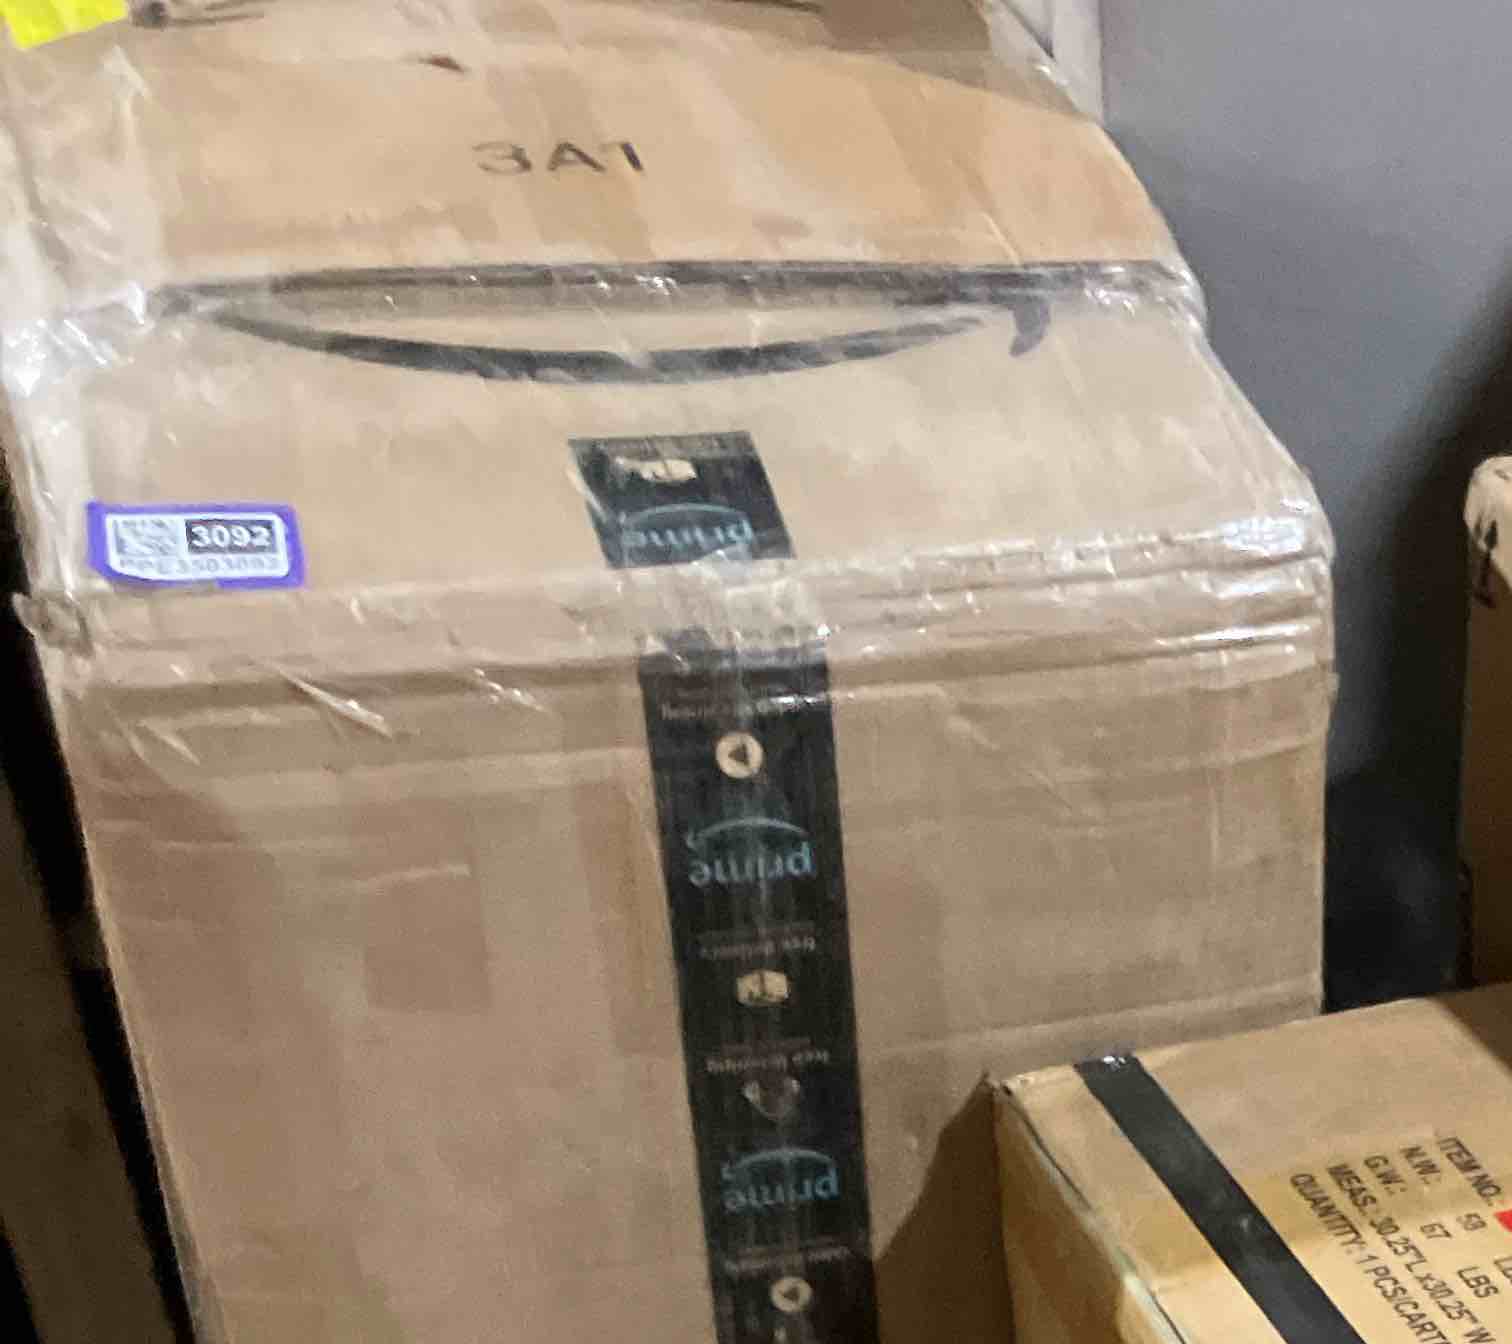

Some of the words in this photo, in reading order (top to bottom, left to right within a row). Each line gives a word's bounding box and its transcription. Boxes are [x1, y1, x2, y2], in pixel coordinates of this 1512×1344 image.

[190, 525, 271, 549] 3092
[688, 842, 816, 888] prime
[723, 1162, 841, 1213] prime
[1457, 1265, 1500, 1299] LBS
